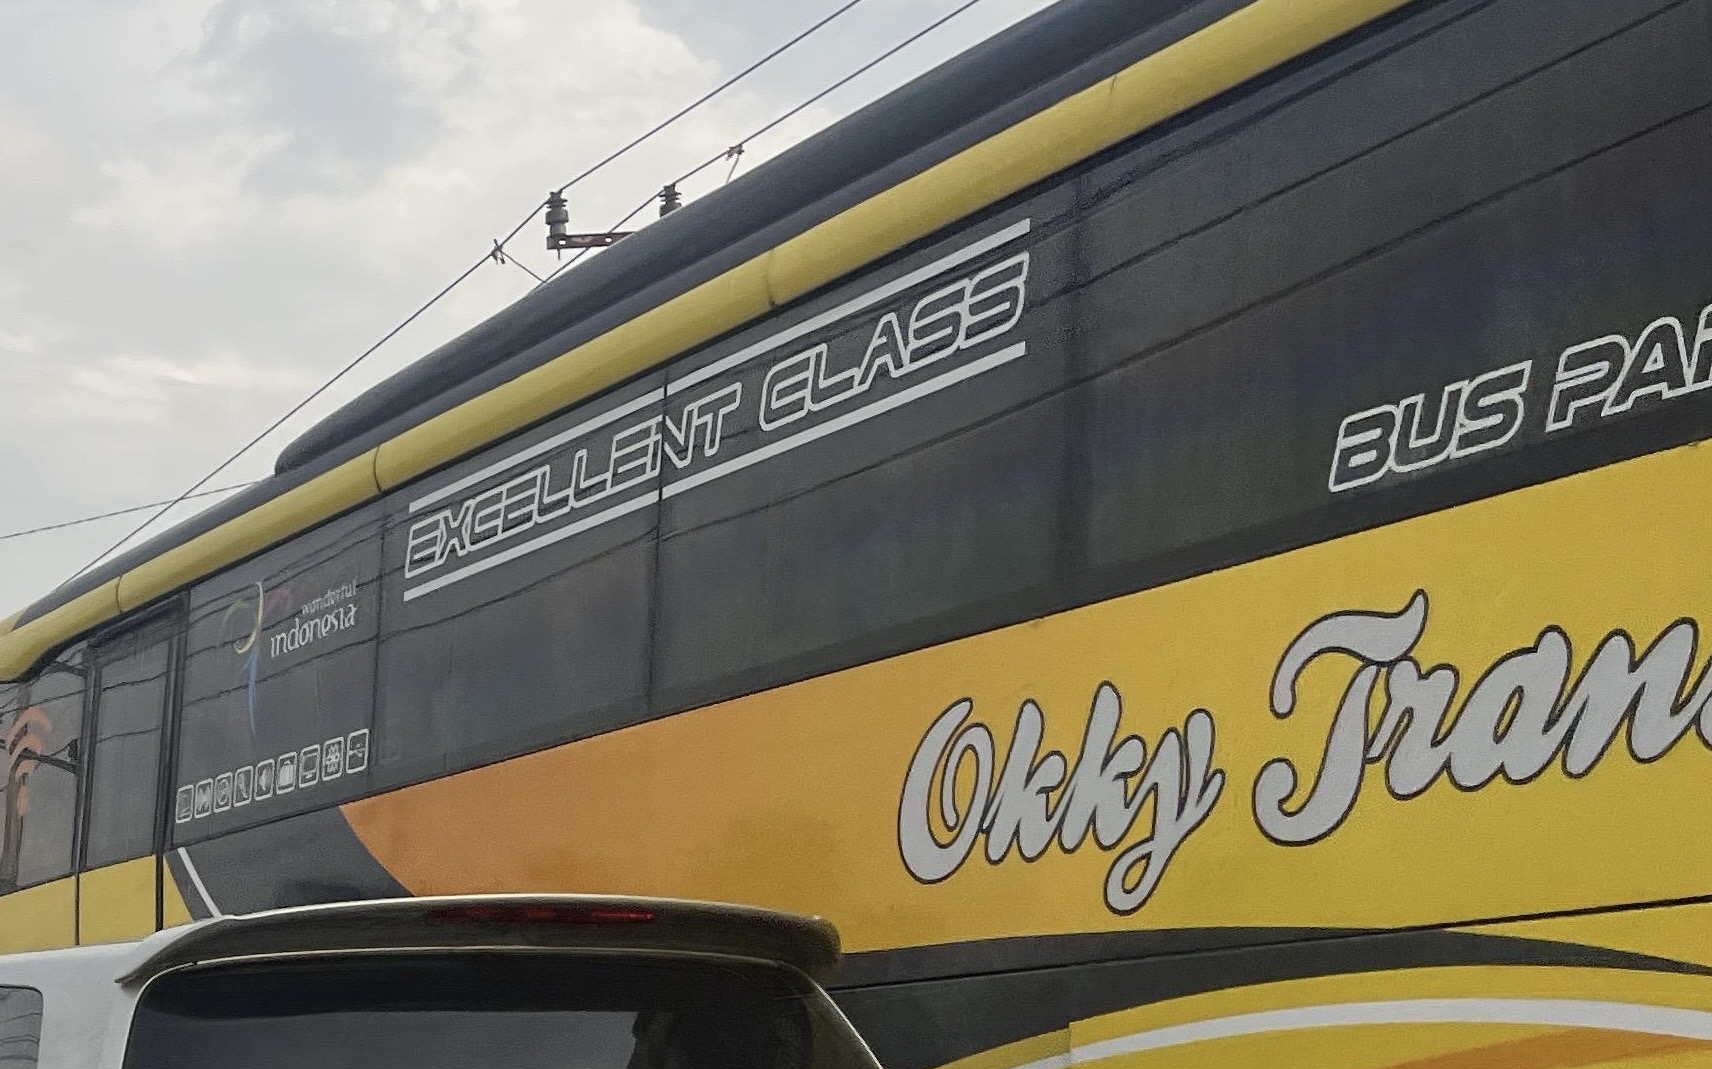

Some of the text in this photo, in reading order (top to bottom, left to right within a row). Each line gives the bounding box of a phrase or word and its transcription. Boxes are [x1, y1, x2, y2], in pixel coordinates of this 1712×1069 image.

[405, 251, 1030, 580] EXCELLENT CLASS
[1328, 360, 1533, 493] BUS
[270, 603, 357, 658] indonesia
[898, 588, 1712, 916] Okky Tran
